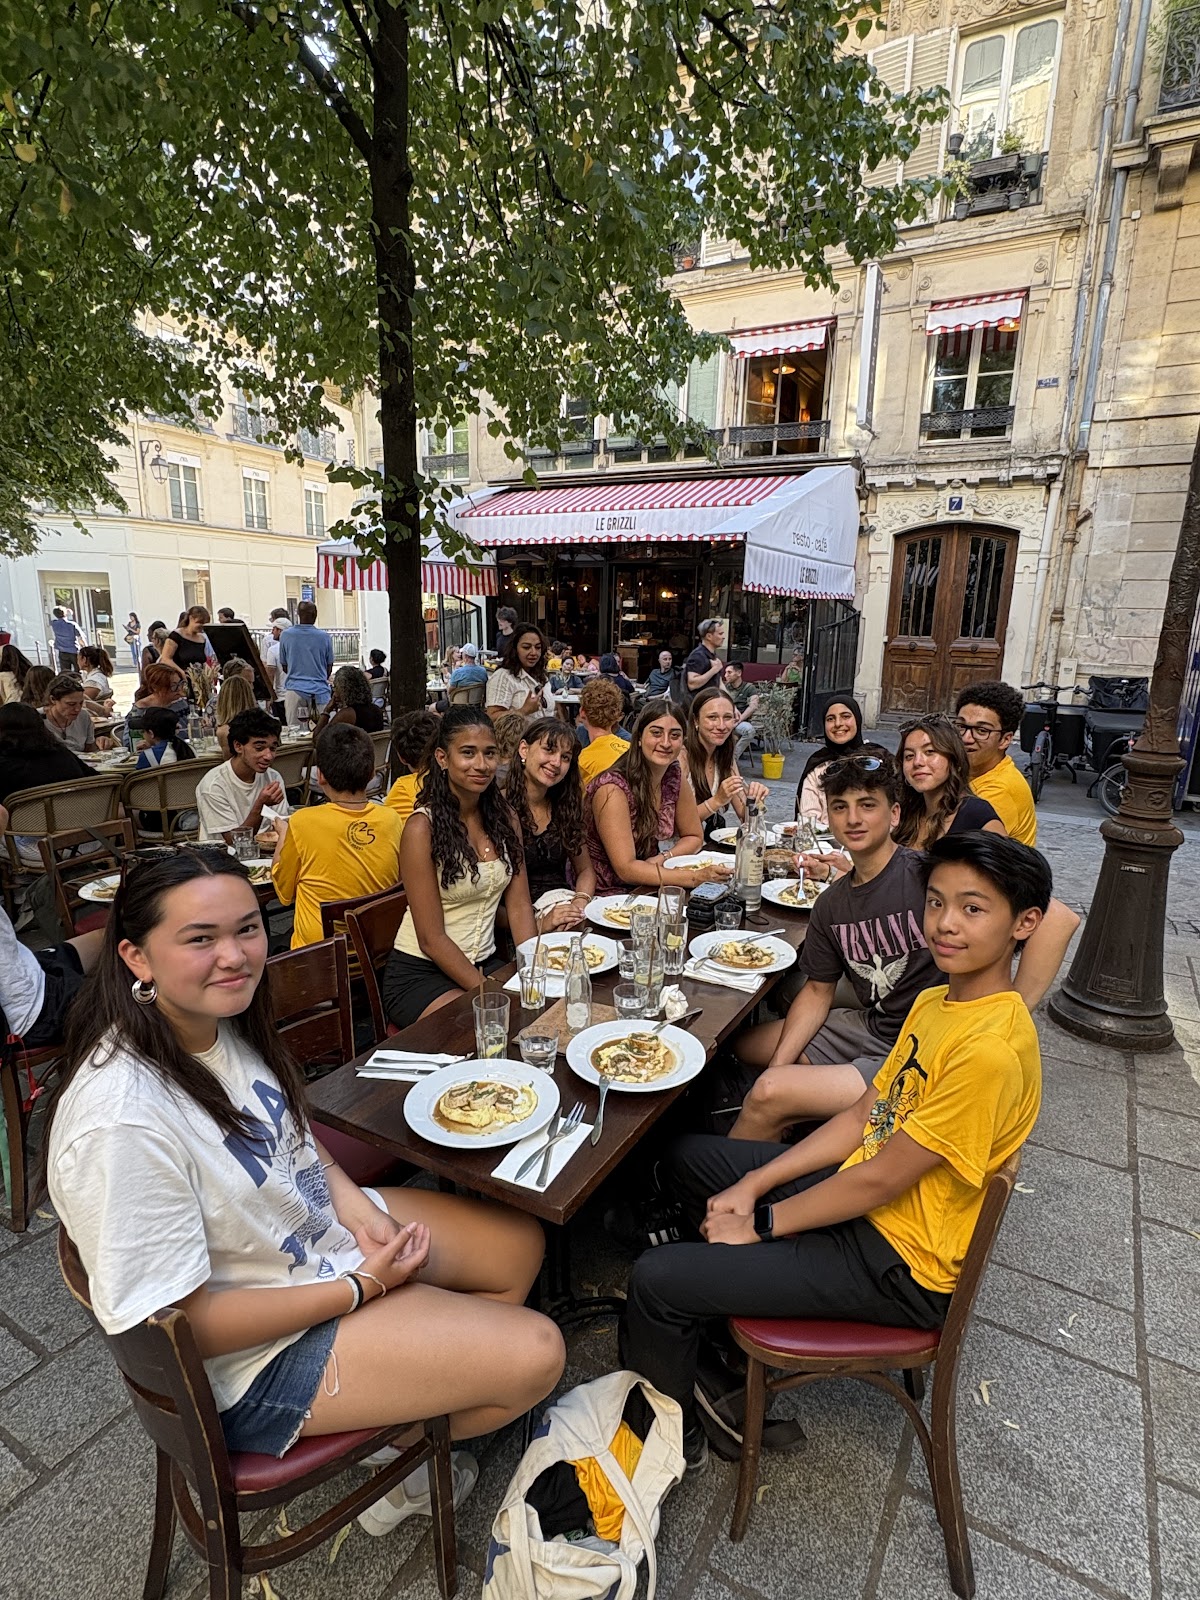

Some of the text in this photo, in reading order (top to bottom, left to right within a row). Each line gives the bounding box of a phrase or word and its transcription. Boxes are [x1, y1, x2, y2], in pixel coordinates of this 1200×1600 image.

[951, 497, 960, 510] 7
[595, 516, 637, 531] LE GRIZZLI
[792, 532, 810, 549] resto
[815, 537, 828, 553] café
[359, 821, 376, 845] 25
